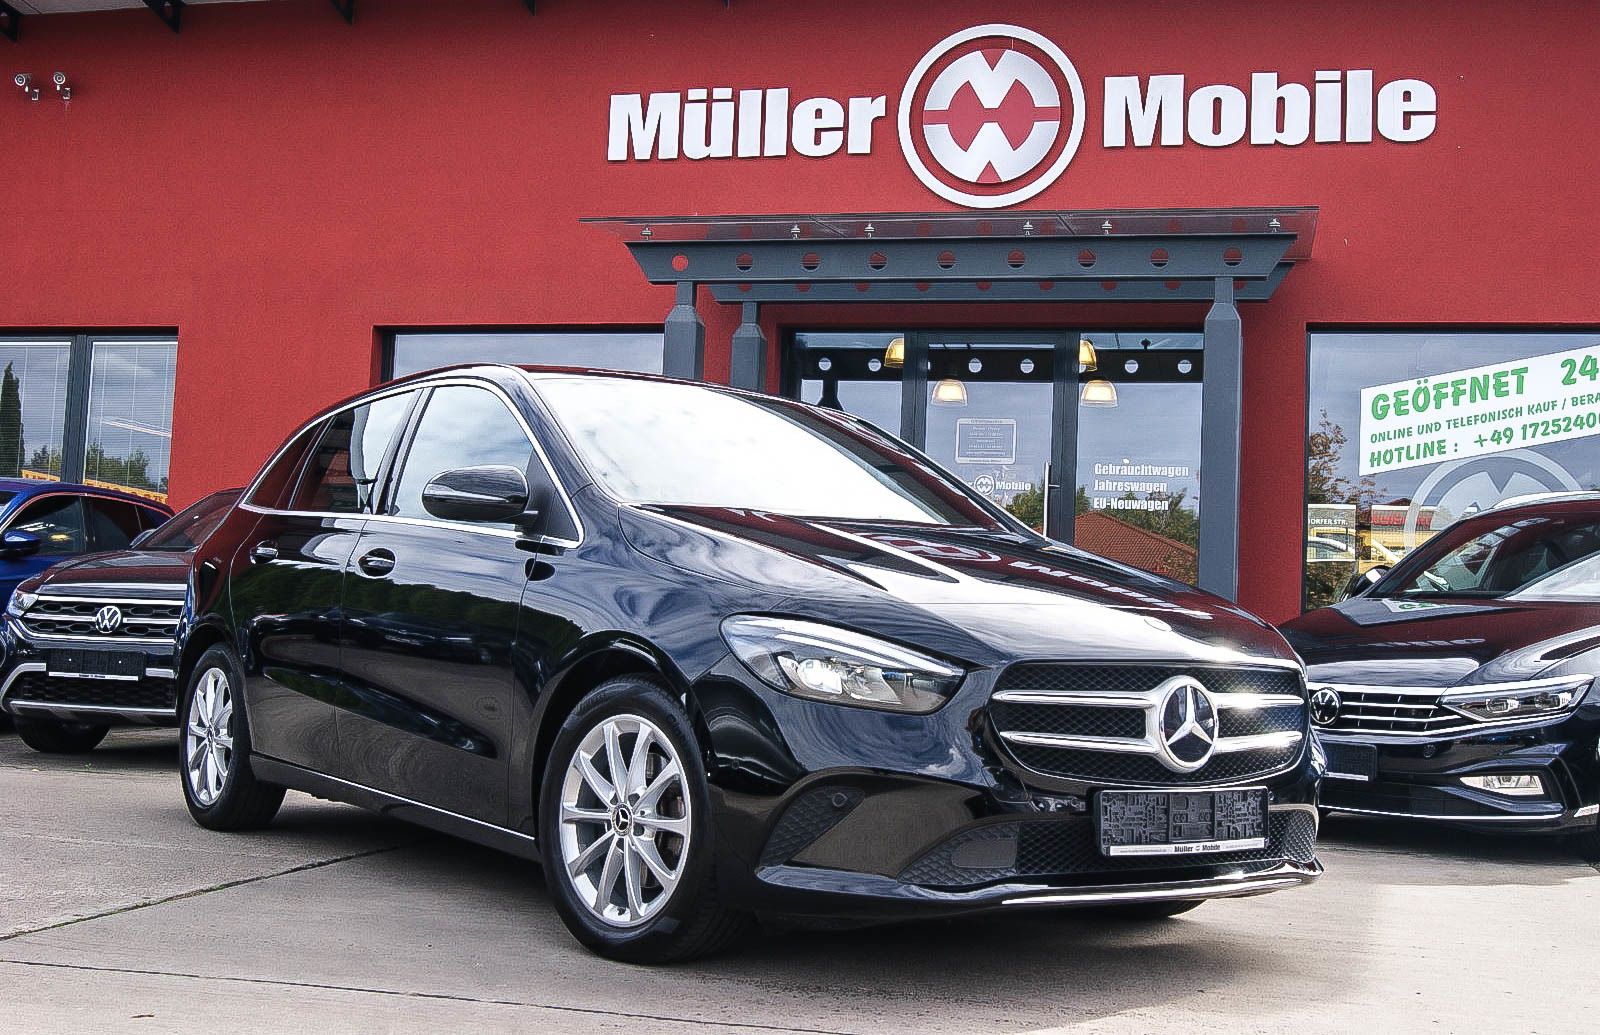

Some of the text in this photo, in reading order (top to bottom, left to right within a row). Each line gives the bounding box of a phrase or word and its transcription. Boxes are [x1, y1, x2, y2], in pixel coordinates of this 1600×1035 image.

[608, 70, 1436, 160] Müller Mobile
[1371, 355, 1599, 420] GEÖFFNET 24
[1370, 426, 1413, 444] ONLINE
[1417, 421, 1442, 436] UND
[1445, 406, 1523, 430] TELEFONISCH
[1527, 400, 1558, 415] KAUF
[1369, 439, 1447, 468] HOTLINE
[1474, 427, 1514, 447] +49
[1521, 412, 1600, 440] 1725240
[1094, 463, 1189, 477] Gebrauchtwagen
[996, 481, 1032, 491] Mobile
[1094, 480, 1167, 493] Jahreswagen
[1093, 497, 1169, 512] EU-Neuwagen
[1174, 845, 1193, 853] Müller
